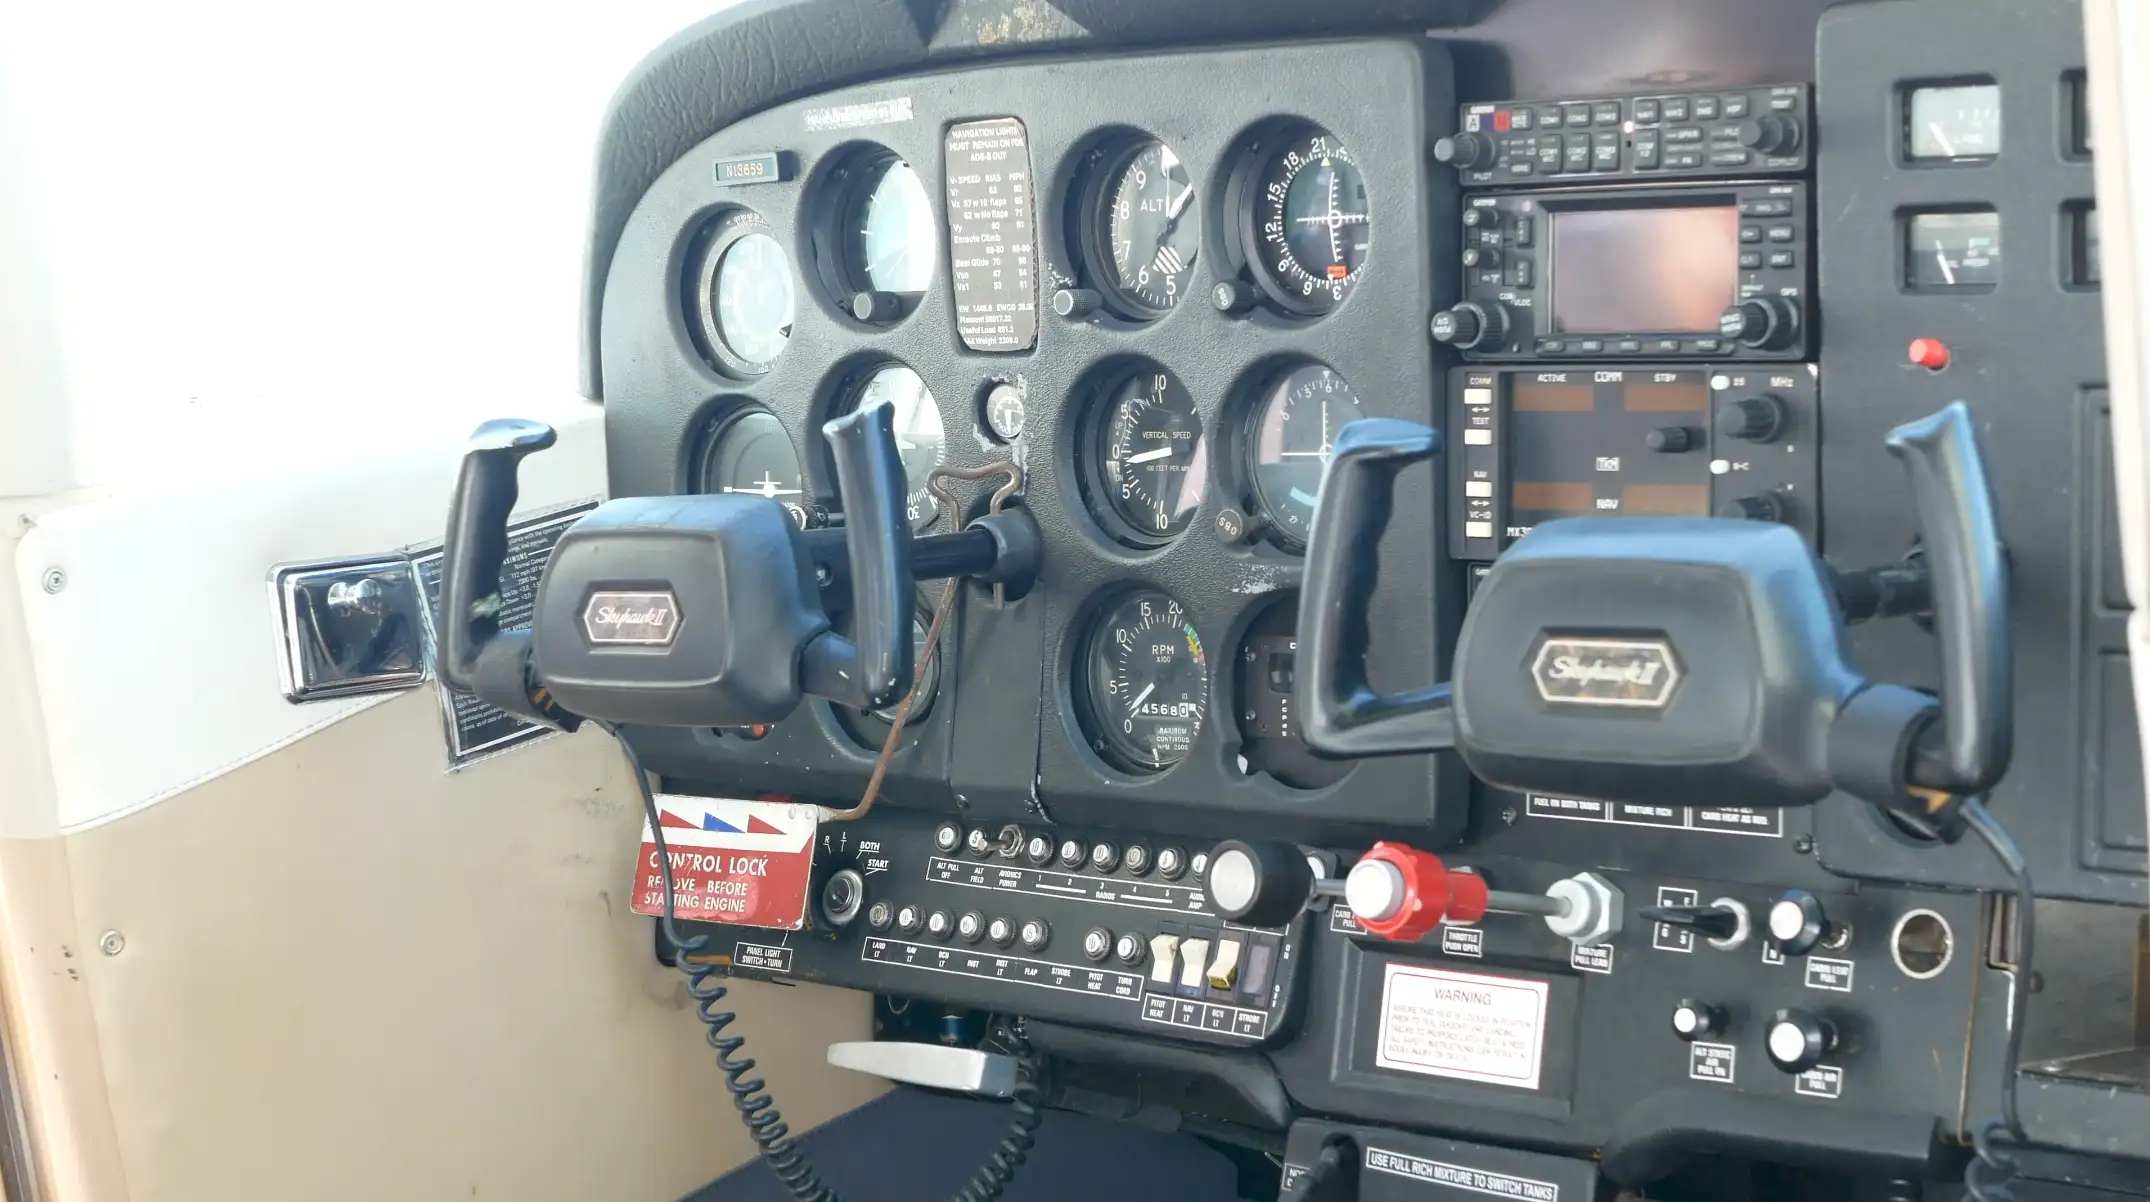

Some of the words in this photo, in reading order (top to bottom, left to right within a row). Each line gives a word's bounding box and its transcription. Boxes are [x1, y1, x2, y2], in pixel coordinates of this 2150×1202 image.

[952, 128, 995, 140] NAVIGATION
[996, 126, 1019, 137] LIGHTS
[950, 141, 970, 151] MUST
[973, 139, 999, 150] REMAIN
[1000, 139, 1010, 148] ON
[1311, 136, 1326, 153] 21
[993, 151, 1007, 160] OUT
[1283, 151, 1300, 171] 18
[726, 162, 763, 178] N13659
[1009, 171, 1024, 181] MPH
[1136, 170, 1146, 191] 9
[1267, 182, 1281, 202] 15
[1120, 200, 1130, 220] 8
[1140, 199, 1164, 212] ALT
[1265, 222, 1278, 242] 12
[981, 233, 1002, 243] Climb
[1122, 240, 1132, 261] 7
[1138, 264, 1149, 285] 6
[1165, 275, 1176, 296] 5
[1333, 286, 1342, 301] 3
[959, 305, 969, 313] EW
[976, 336, 997, 346] Weight
[1154, 374, 1167, 391] 10
[1470, 377, 1491, 385] COMM
[1537, 373, 1567, 382] ACTIVE
[1594, 371, 1622, 383] COMM
[1654, 373, 1676, 382] STBY
[1771, 376, 1794, 387] MHz
[1121, 403, 1129, 420] 5
[1115, 422, 1124, 430] UP
[1472, 417, 1490, 425] TEST
[1142, 431, 1169, 440] VERTICAL
[1172, 431, 1192, 440] SPEED
[1112, 444, 1120, 459] 0
[1122, 484, 1130, 499] 5
[1597, 498, 1618, 510] NAV
[1156, 513, 1168, 530] 10
[1140, 602, 1151, 616] 15
[595, 606, 656, 630] Skyhawk
[1116, 628, 1127, 643] 10
[1152, 644, 1175, 655] RPM
[1110, 680, 1118, 694] 5
[1124, 719, 1132, 734] 0
[825, 836, 831, 844] R
[860, 841, 880, 851] BOTH
[729, 853, 769, 877] LOCK
[868, 859, 889, 869] START
[937, 862, 947, 870] ALT
[948, 863, 960, 872] PULL
[941, 872, 951, 880] OFF
[974, 866, 984, 875] ALT
[999, 869, 1022, 879] AVIONICS
[647, 874, 696, 892] REVE
[707, 879, 749, 896] BEFORE
[970, 875, 985, 885] FIELD
[999, 879, 1018, 889] POWER
[644, 891, 700, 908] STATING
[704, 896, 746, 913] ENGINE
[1188, 901, 1203, 910] AMP
[1448, 931, 1478, 943] THROTTLE
[872, 942, 886, 950] LAND
[746, 946, 763, 956] PANEL
[765, 949, 781, 958] LIGHT
[907, 955, 913, 963] LT
[938, 959, 945, 967] LT
[967, 959, 980, 968] INST
[996, 968, 1004, 976] LT
[1024, 967, 1038, 976] FLAP
[1051, 967, 1071, 977] STROBE
[1118, 976, 1133, 986] TURN
[1434, 986, 1492, 1006] WARNING
[1150, 999, 1166, 1008] PITOT
[1149, 1009, 1164, 1018] HEAT
[1183, 1014, 1190, 1023] LT
[1238, 1013, 1260, 1024] STROBE
[1213, 1019, 1219, 1027] LT
[1370, 1152, 1389, 1168] USE
[1389, 1156, 1411, 1173] FULL
[1412, 1161, 1433, 1178] RICH
[1434, 1165, 1472, 1185] MIXTURE
[1473, 1173, 1487, 1188] TO
[1487, 1176, 1522, 1195] SWITCH
[1523, 1182, 1553, 1201] TANKS
